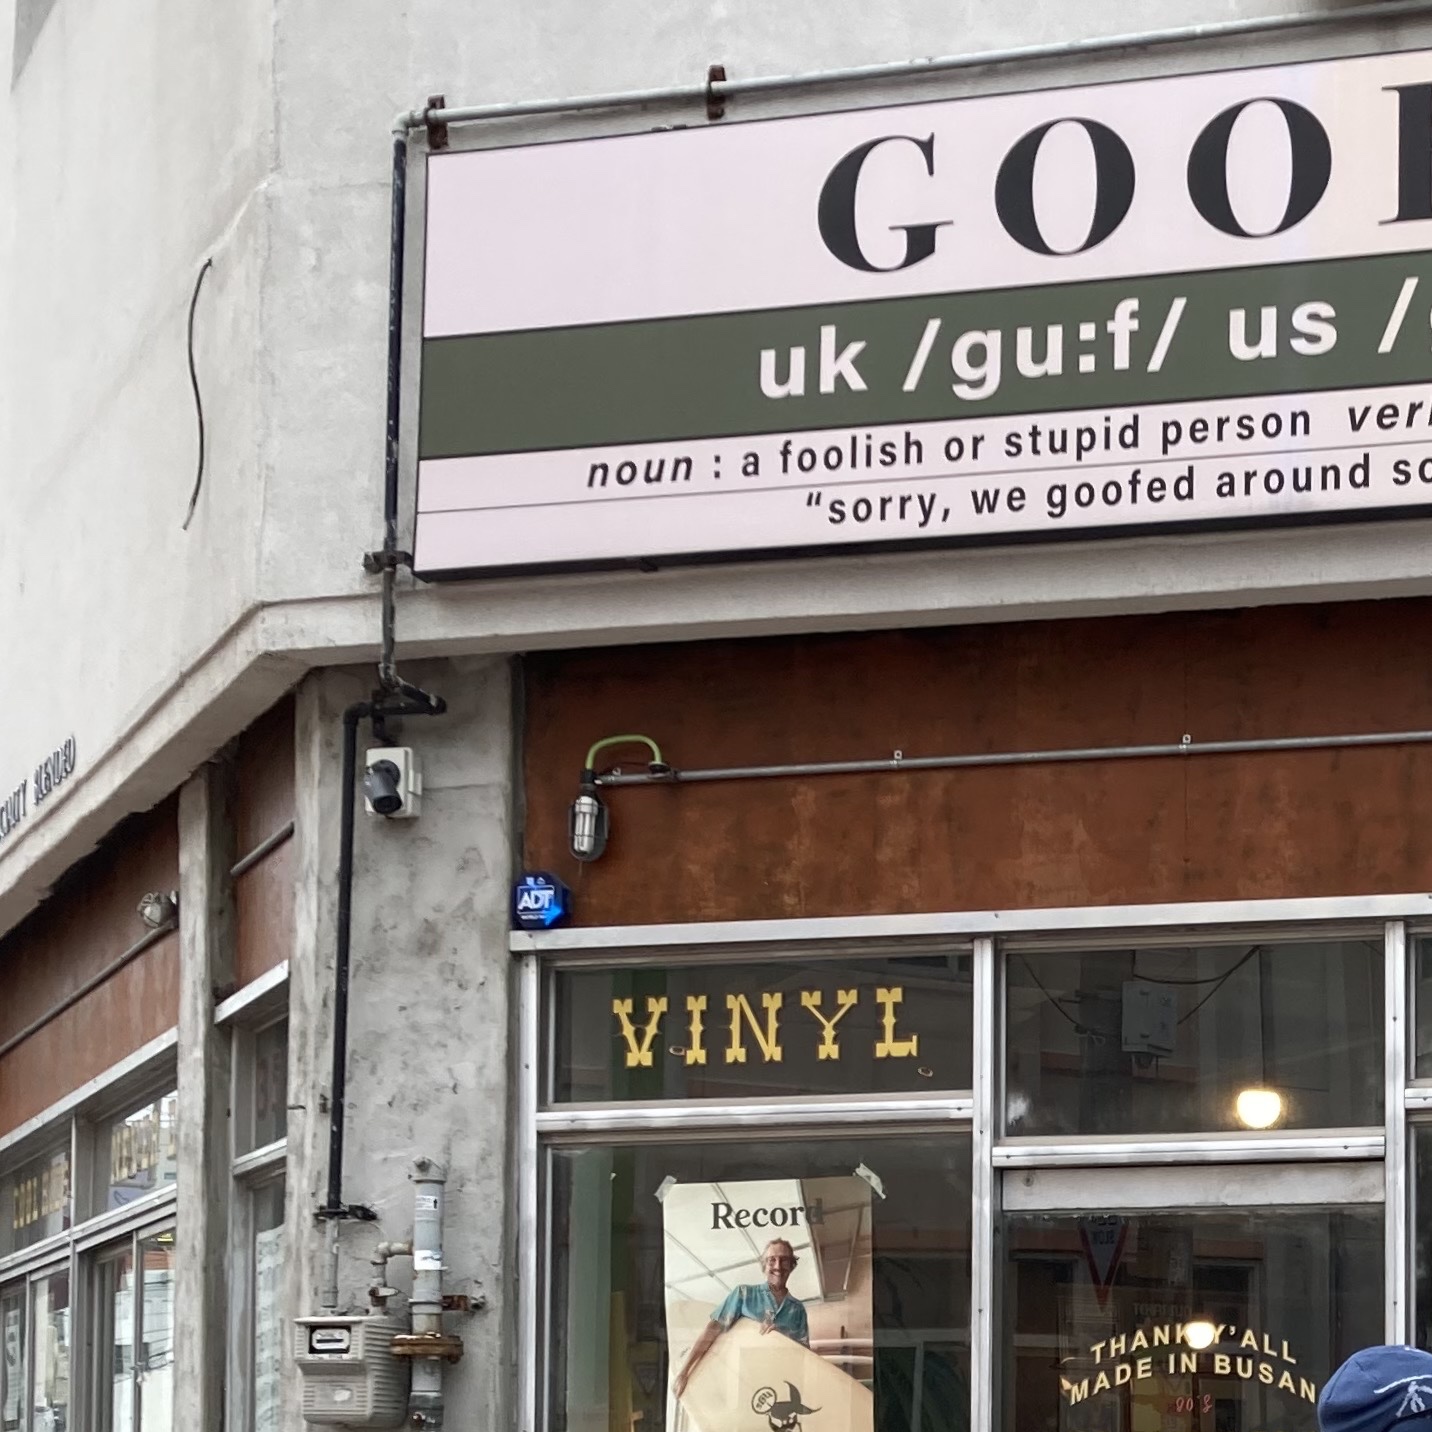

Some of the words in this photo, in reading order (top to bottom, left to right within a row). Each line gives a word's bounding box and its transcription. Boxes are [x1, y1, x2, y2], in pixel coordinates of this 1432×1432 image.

[761, 325, 867, 398] uk
[903, 297, 1186, 400] /gu:f/
[1230, 302, 1337, 360] us
[588, 457, 692, 487] noun
[742, 453, 759, 476] a
[780, 432, 922, 473] foolish
[945, 435, 984, 461] or
[1005, 414, 1139, 461] stupid
[1162, 403, 1309, 455] person
[971, 487, 1025, 514] we
[1047, 466, 1193, 518] goofed
[1217, 453, 1369, 497] around
[518, 890, 554, 910] ADT
[612, 987, 918, 1068] VINYL
[711, 1198, 824, 1230] Record
[1069, 1356, 1153, 1406] MADE
[1168, 1353, 1197, 1375] IN
[1214, 1353, 1317, 1404] BUSAN
